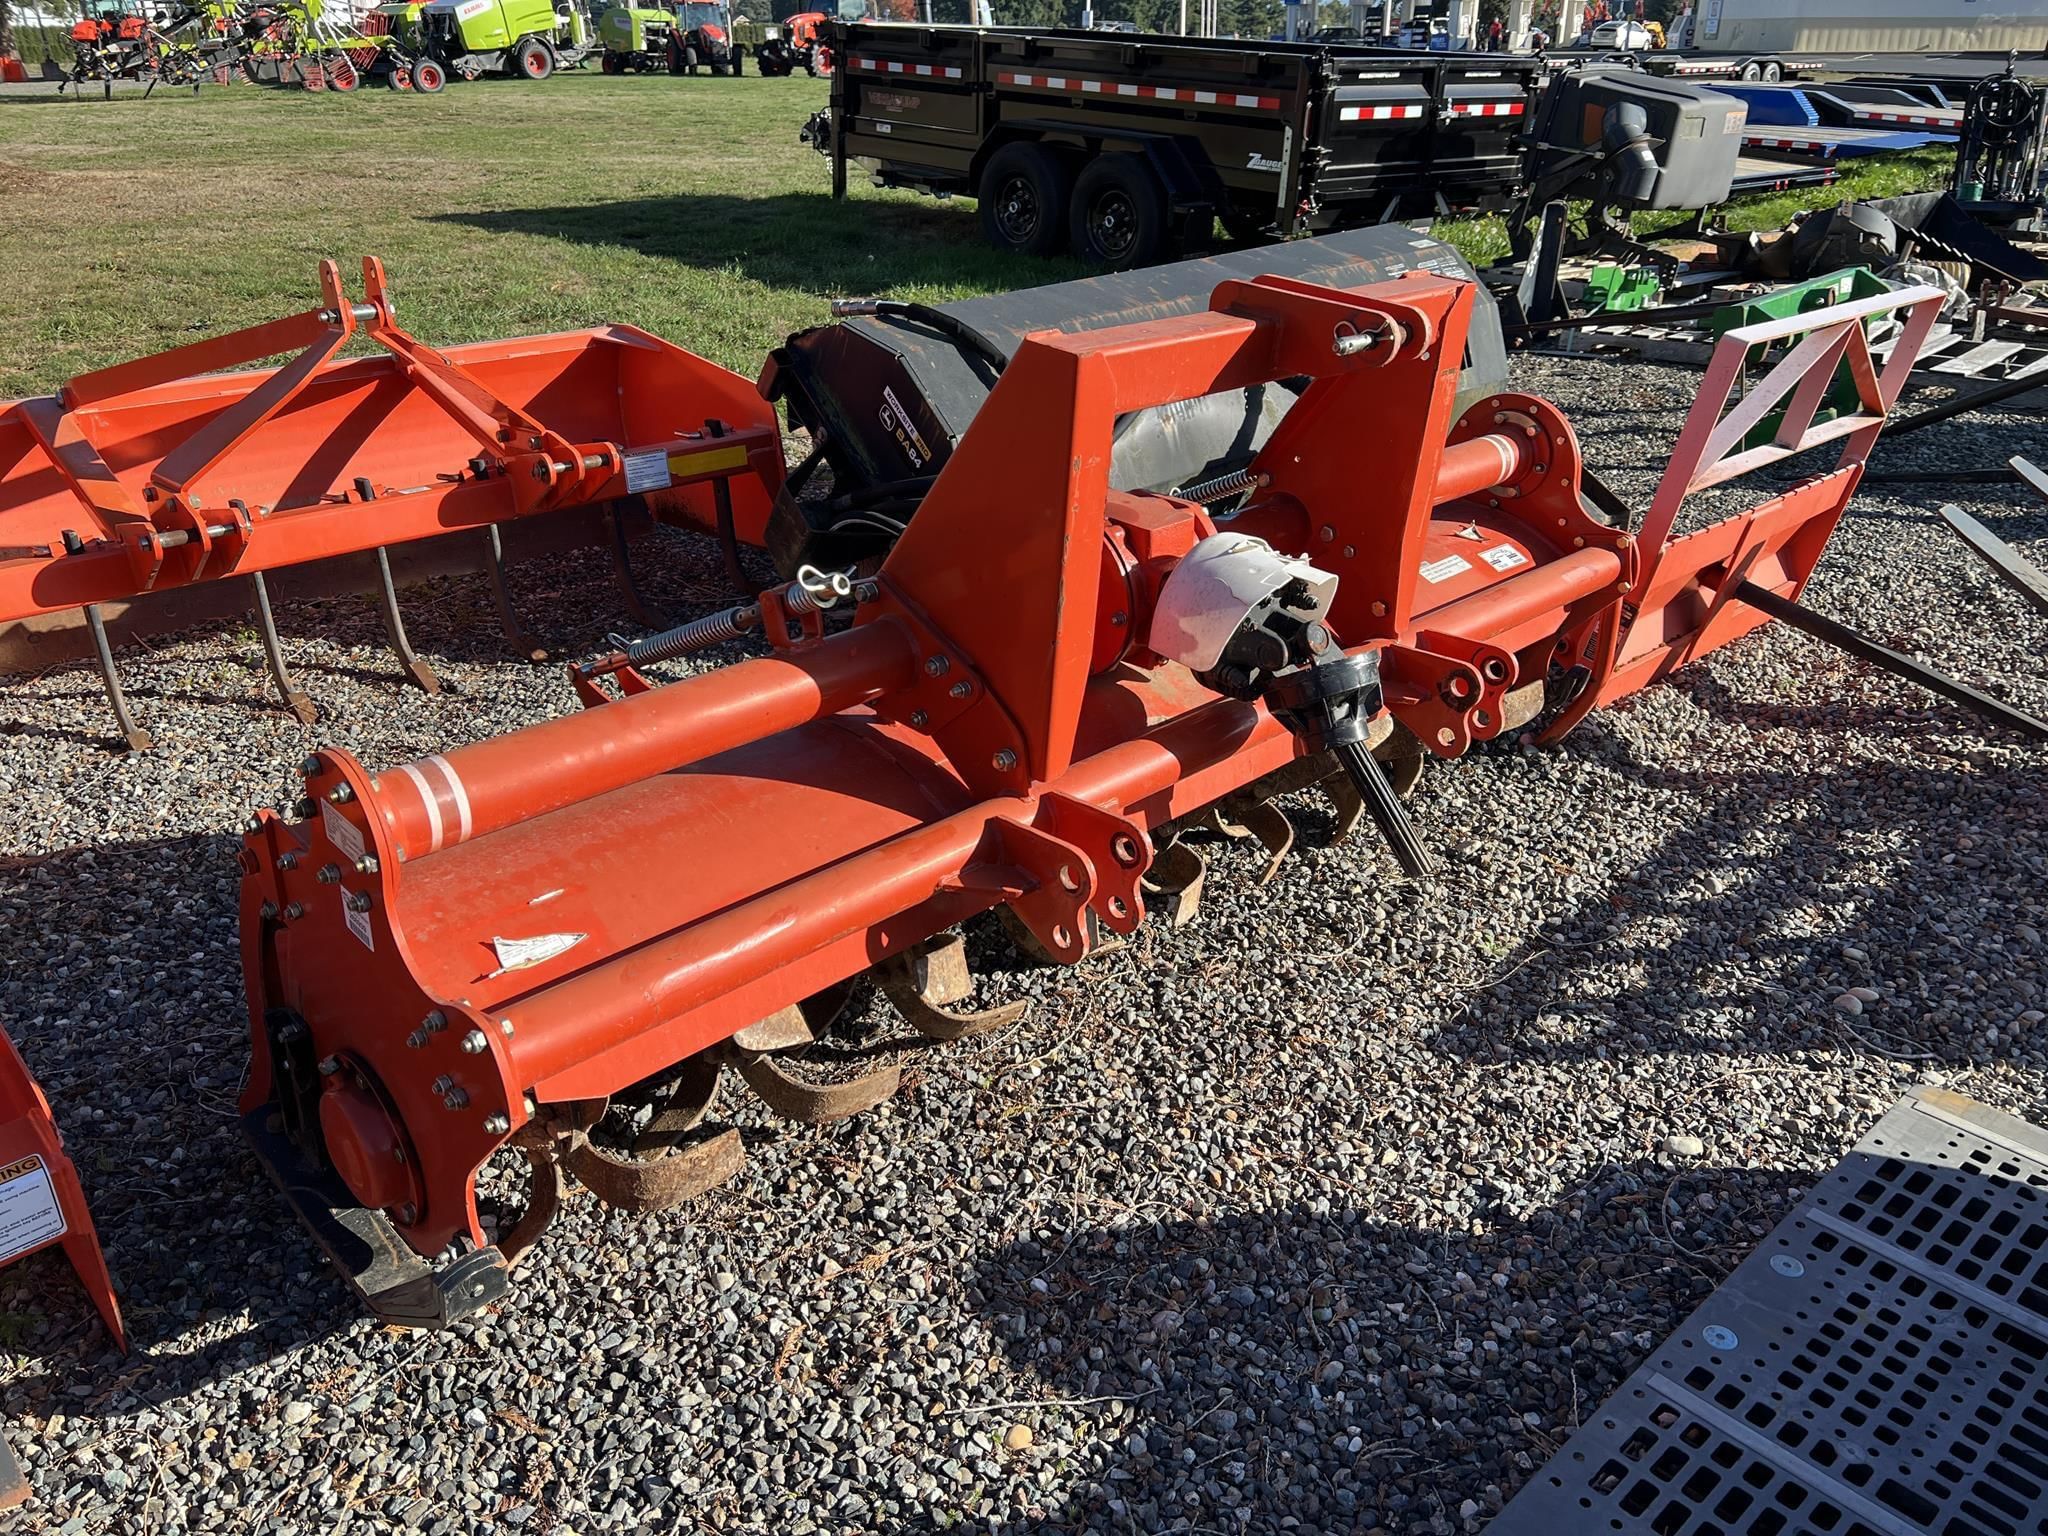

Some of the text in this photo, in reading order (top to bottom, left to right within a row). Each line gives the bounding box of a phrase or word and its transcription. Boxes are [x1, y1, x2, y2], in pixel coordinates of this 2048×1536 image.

[887, 390, 929, 457] WORKSITE PRO
[0, 1159, 38, 1181] ING
